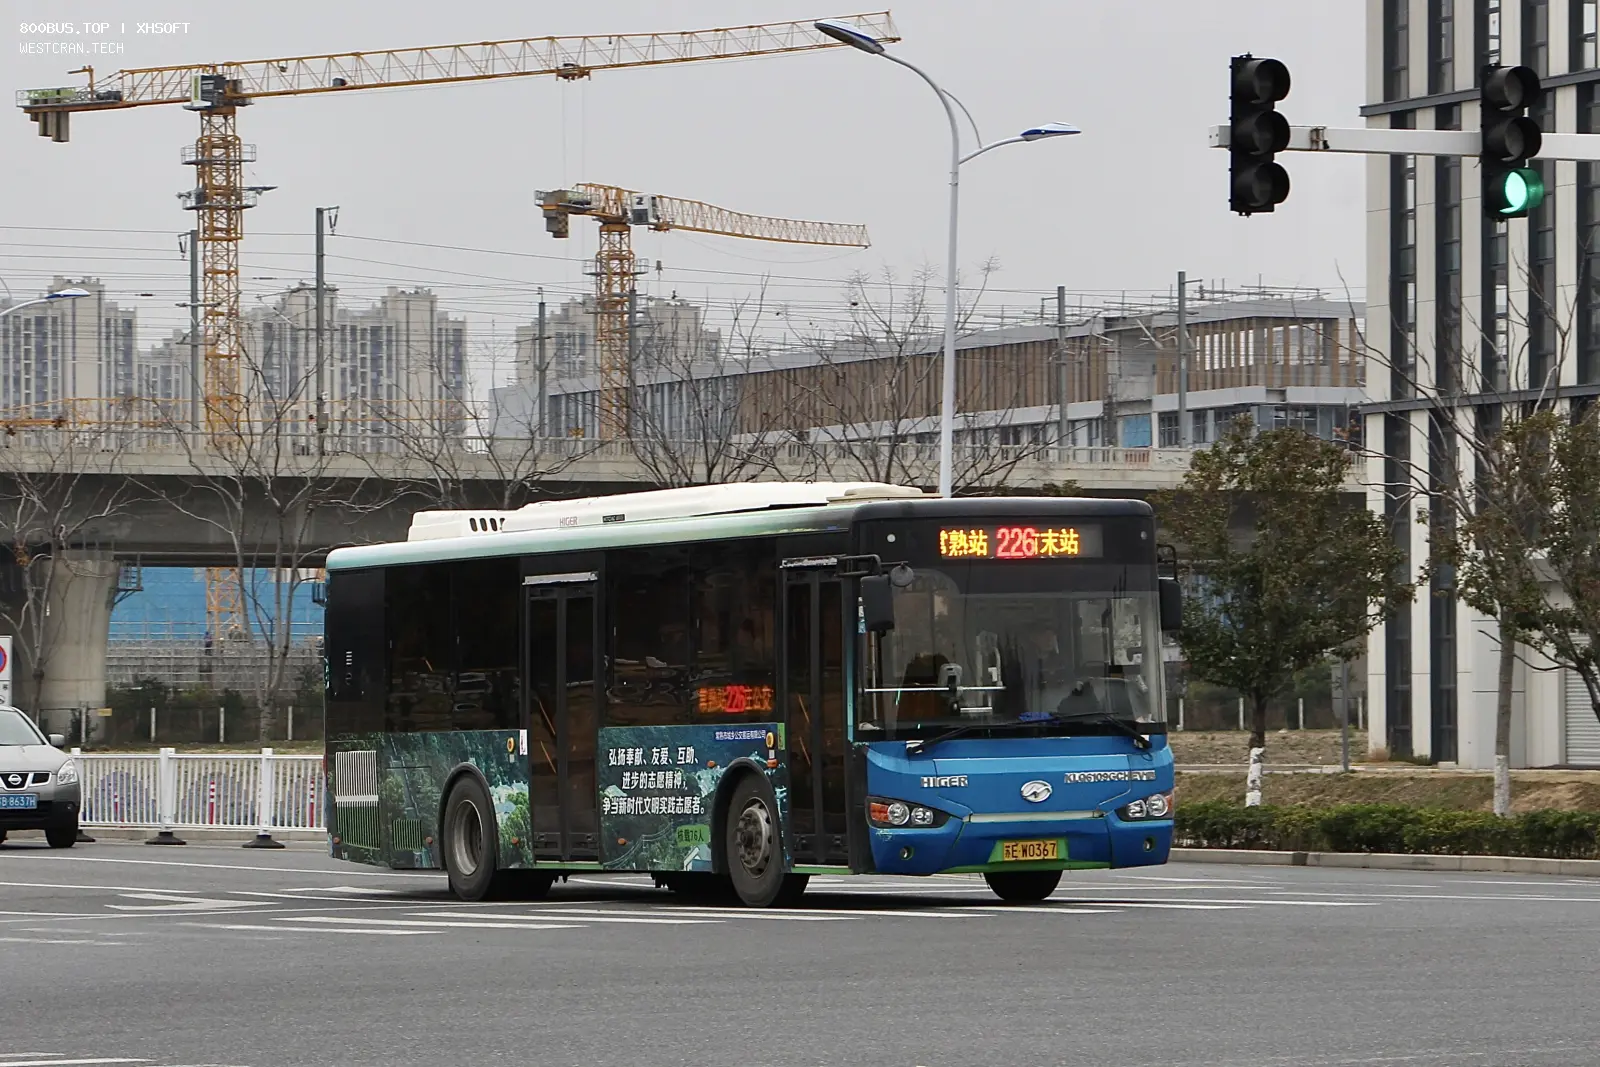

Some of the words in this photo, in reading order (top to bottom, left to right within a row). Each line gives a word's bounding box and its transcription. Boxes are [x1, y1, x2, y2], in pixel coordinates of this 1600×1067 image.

[559, 515, 579, 528] HIGER
[995, 527, 1036, 557] 226
[608, 746, 700, 766] 弘扬奉献、友爱、互助、
[920, 775, 968, 788] HIGER
[602, 796, 705, 816] 争当新时代文明实践志愿者。
